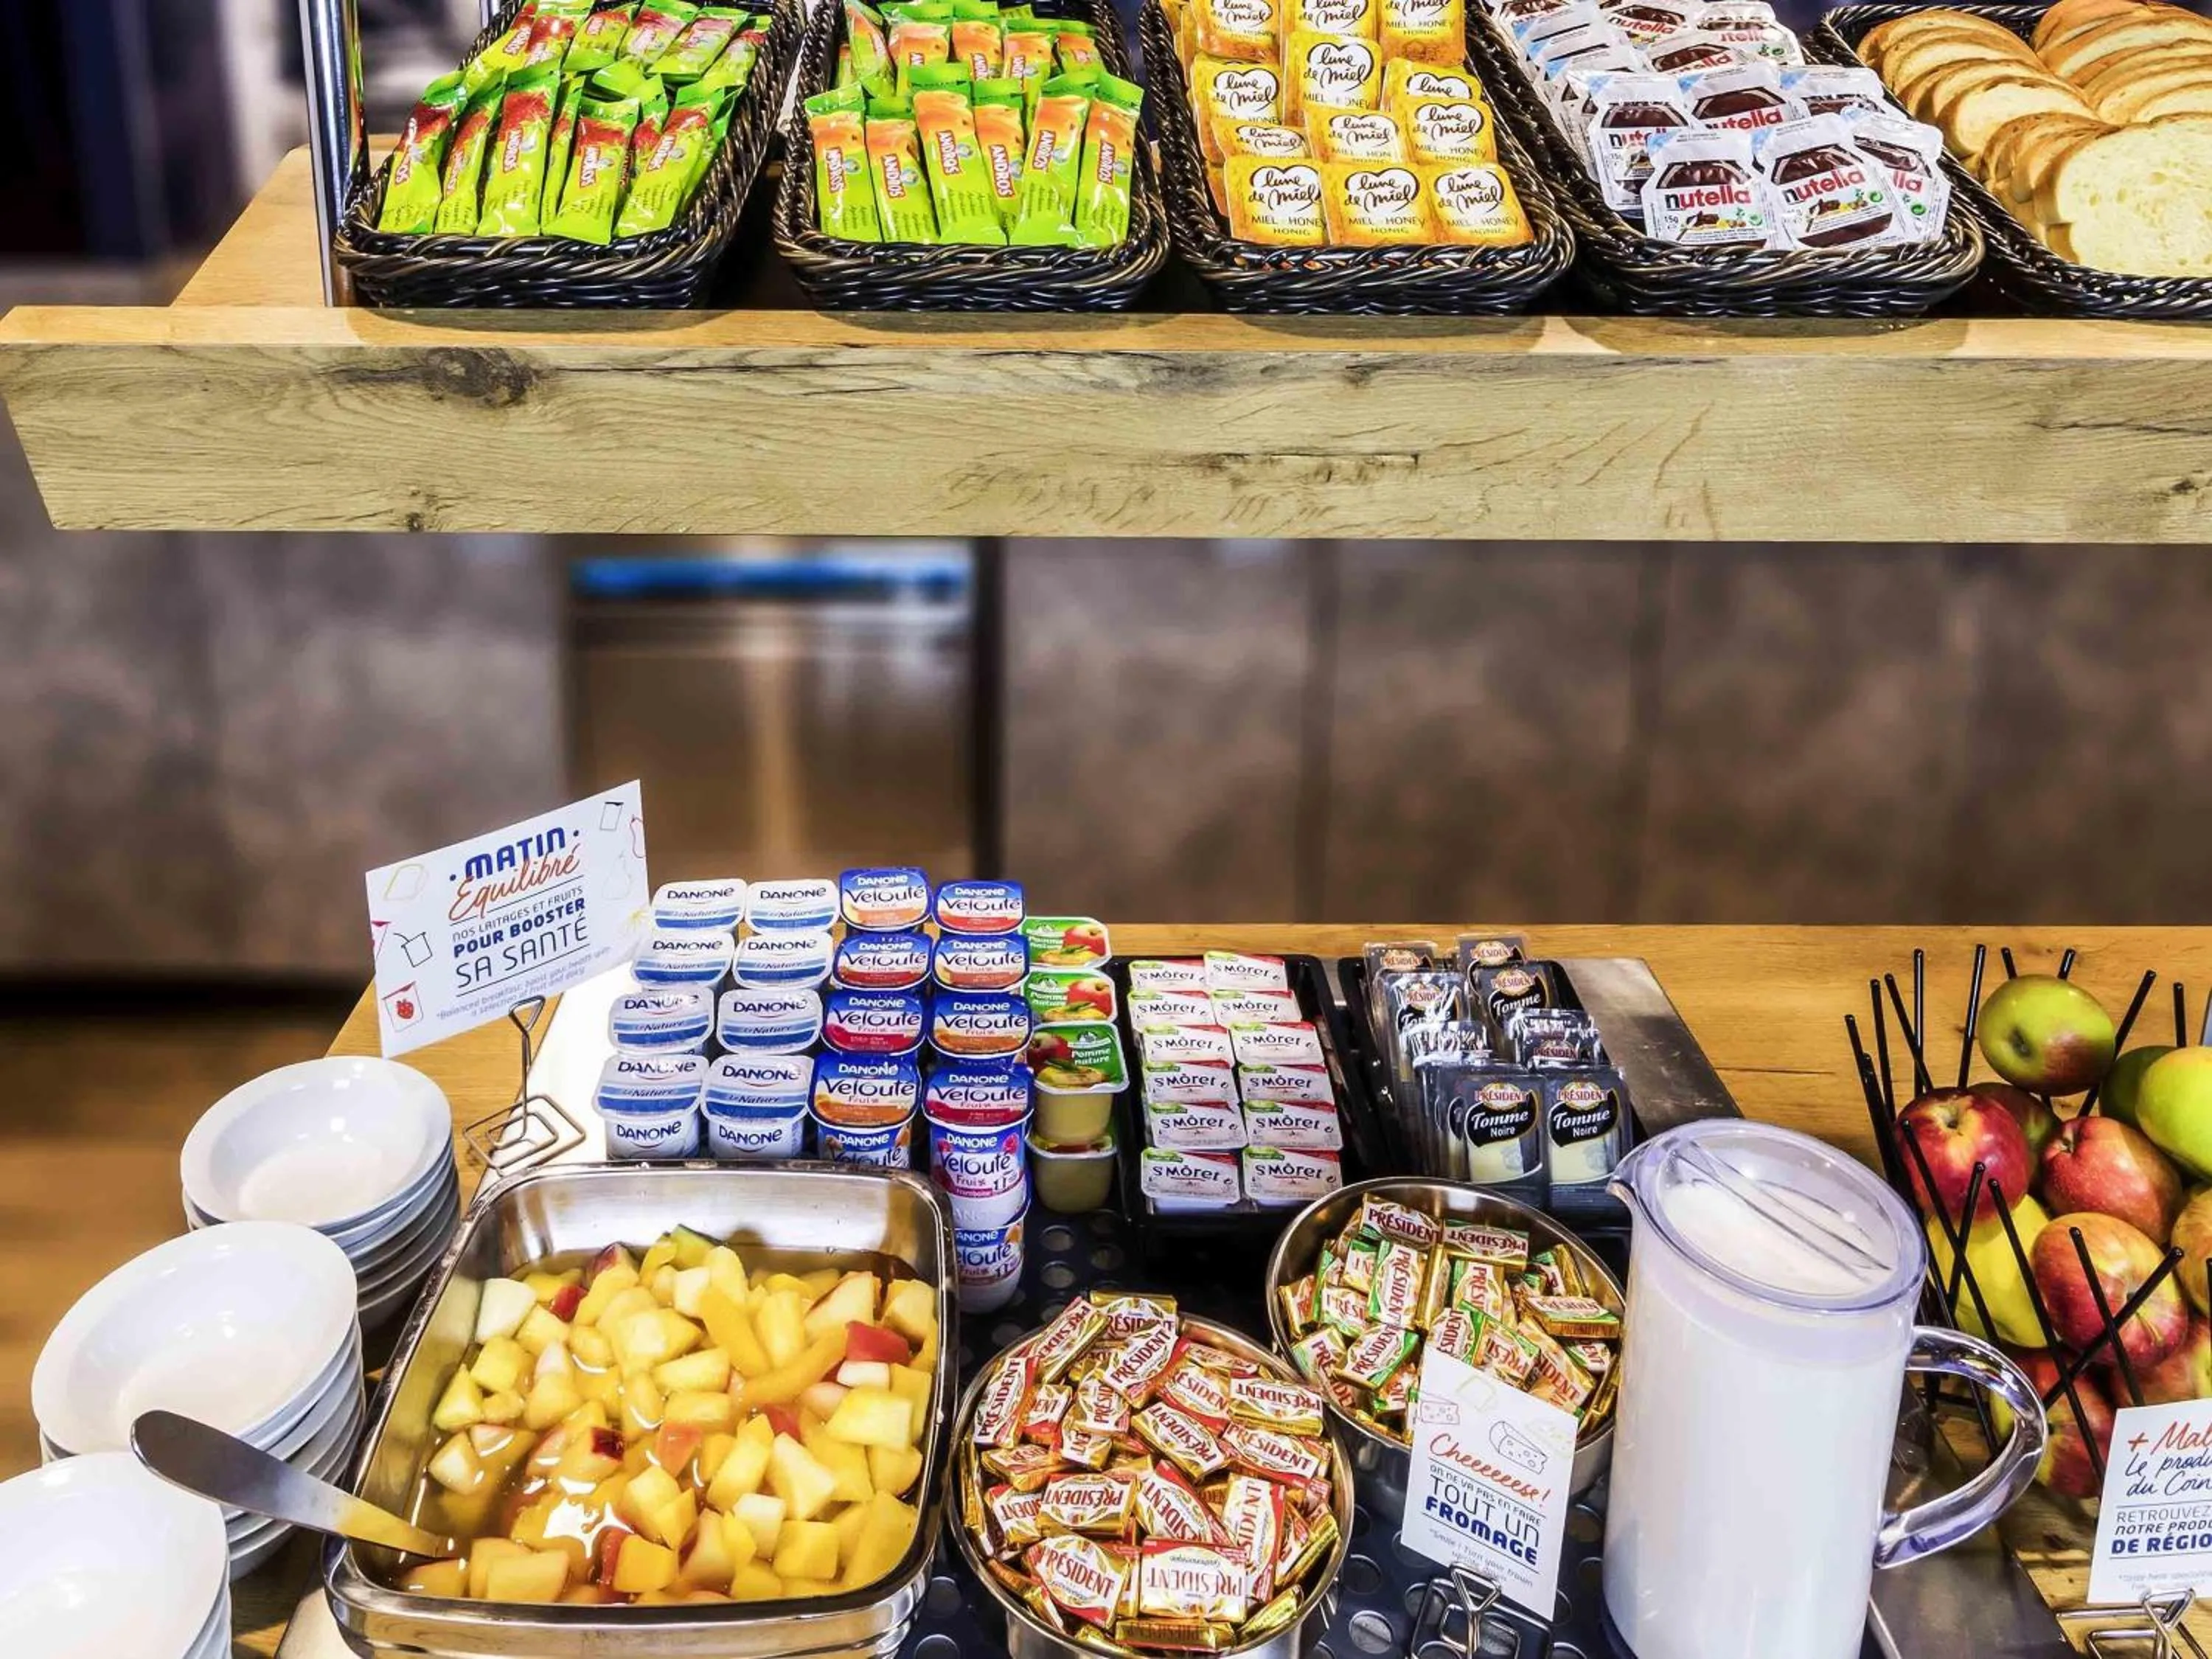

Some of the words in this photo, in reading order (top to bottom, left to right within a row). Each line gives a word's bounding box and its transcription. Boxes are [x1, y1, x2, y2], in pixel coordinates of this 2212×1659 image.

[1608, 17, 1676, 35] nutella
[1318, 47, 1354, 65] lune
[1226, 74, 1262, 90] lune
[1320, 64, 1367, 89] miel
[1417, 76, 1454, 96] lune
[1230, 88, 1272, 112] miel
[1426, 105, 1464, 121] lune
[1431, 120, 1476, 144] miel
[938, 131, 960, 175] ANDROS
[1034, 131, 1055, 171] ANDROS
[991, 145, 1015, 198] ANDROS
[1099, 142, 1116, 184] ANDROS
[884, 155, 905, 198] ANDROS
[1262, 170, 1304, 188] lune
[1358, 175, 1397, 190] lune
[1447, 176, 1486, 194] lune
[1782, 168, 1867, 204] nutella
[1248, 189, 1265, 203] de
[1268, 184, 1316, 212] miel
[1344, 194, 1362, 206] de
[1364, 184, 1411, 212] miel
[1456, 186, 1500, 214] miel
[1664, 184, 1753, 209] nutella
[1251, 215, 1278, 225] MIEL
[1287, 216, 1326, 229] HONEY
[1349, 217, 1374, 225] MIEL
[1385, 216, 1425, 228] HONEY
[465, 827, 566, 880] MATIN
[667, 887, 734, 900] DANONE
[760, 887, 827, 900] DANONE
[845, 886, 925, 903] Velouté
[452, 926, 476, 942] NOS
[479, 906, 530, 932] LAITAGES
[532, 901, 546, 913] ET
[548, 886, 583, 907] FRUITS
[942, 897, 1020, 911] Velouté
[453, 930, 504, 958] POUR
[509, 897, 586, 938] BOOSTER
[456, 955, 492, 989] SA
[502, 912, 588, 971] SANTÉ
[653, 940, 723, 950] DANONE
[748, 939, 817, 950] DANONE
[844, 951, 927, 967] Velouté
[938, 951, 1023, 967] Velouté
[849, 997, 906, 1008] DANONE
[953, 1002, 1010, 1011] DANONE
[1492, 993, 1541, 1016] Tomme
[833, 1007, 921, 1026] Velouté
[939, 1013, 1027, 1029] Velouté
[1071, 1047, 1110, 1058] Pomme
[1074, 1055, 1110, 1065] nature
[838, 1062, 899, 1076] DANONE
[948, 1074, 1009, 1084] DANONE
[821, 1074, 915, 1096] Velouté
[931, 1086, 1026, 1102] Velouté
[1557, 1088, 1609, 1102] PRÉSIDENT
[1476, 1090, 1528, 1102] PRÉSIDENT
[616, 1120, 682, 1138] DANONE
[1471, 1110, 1528, 1130] Tomme
[1553, 1109, 1611, 1130] Tomme
[719, 1124, 783, 1144] DANONE
[838, 1133, 890, 1147] DANONE
[945, 1132, 998, 1148] DANONE
[1490, 1127, 1515, 1138] Noire
[1573, 1126, 1598, 1138] Noire
[941, 1150, 1012, 1175] Velouté
[1368, 1208, 1444, 1243] PRÉSIDENT
[955, 1231, 999, 1242] ANONE
[1448, 1229, 1527, 1251] PRÉSIDENT
[1388, 1249, 1411, 1325] PRÉSIDENT
[1111, 1329, 1172, 1384] PRÉSIDENT
[1352, 1323, 1400, 1375] PRÉSIDENT
[978, 1360, 1020, 1437] PRÉSIDENT
[1236, 1383, 1322, 1412] PRÉSIDENT
[1148, 1406, 1217, 1463] PRÉSIDENT
[1227, 1423, 1312, 1470] PRÉSIDENT
[2125, 1452, 2149, 1477] Le
[2126, 1475, 2158, 1498] du
[2164, 1470, 2212, 1496] Coin
[1043, 1488, 1124, 1508] PRÉSIDENT
[1461, 1479, 1474, 1492] VA
[1477, 1487, 1496, 1502] PAS
[1514, 1506, 1541, 1527] FAIRE
[1430, 1474, 1496, 1521] TOUT
[1505, 1513, 1540, 1547] UN
[2117, 1505, 2211, 1523] RETROUVEZ
[1425, 1495, 1537, 1566] FROMAGE
[2115, 1523, 2164, 1536] NOTRE
[2111, 1539, 2140, 1554] DE
[2146, 1531, 2212, 1553] RÉGIO
[1043, 1546, 1115, 1599] PRÉSIDENT
[1147, 1566, 1242, 1597] PRÉSIDENT
